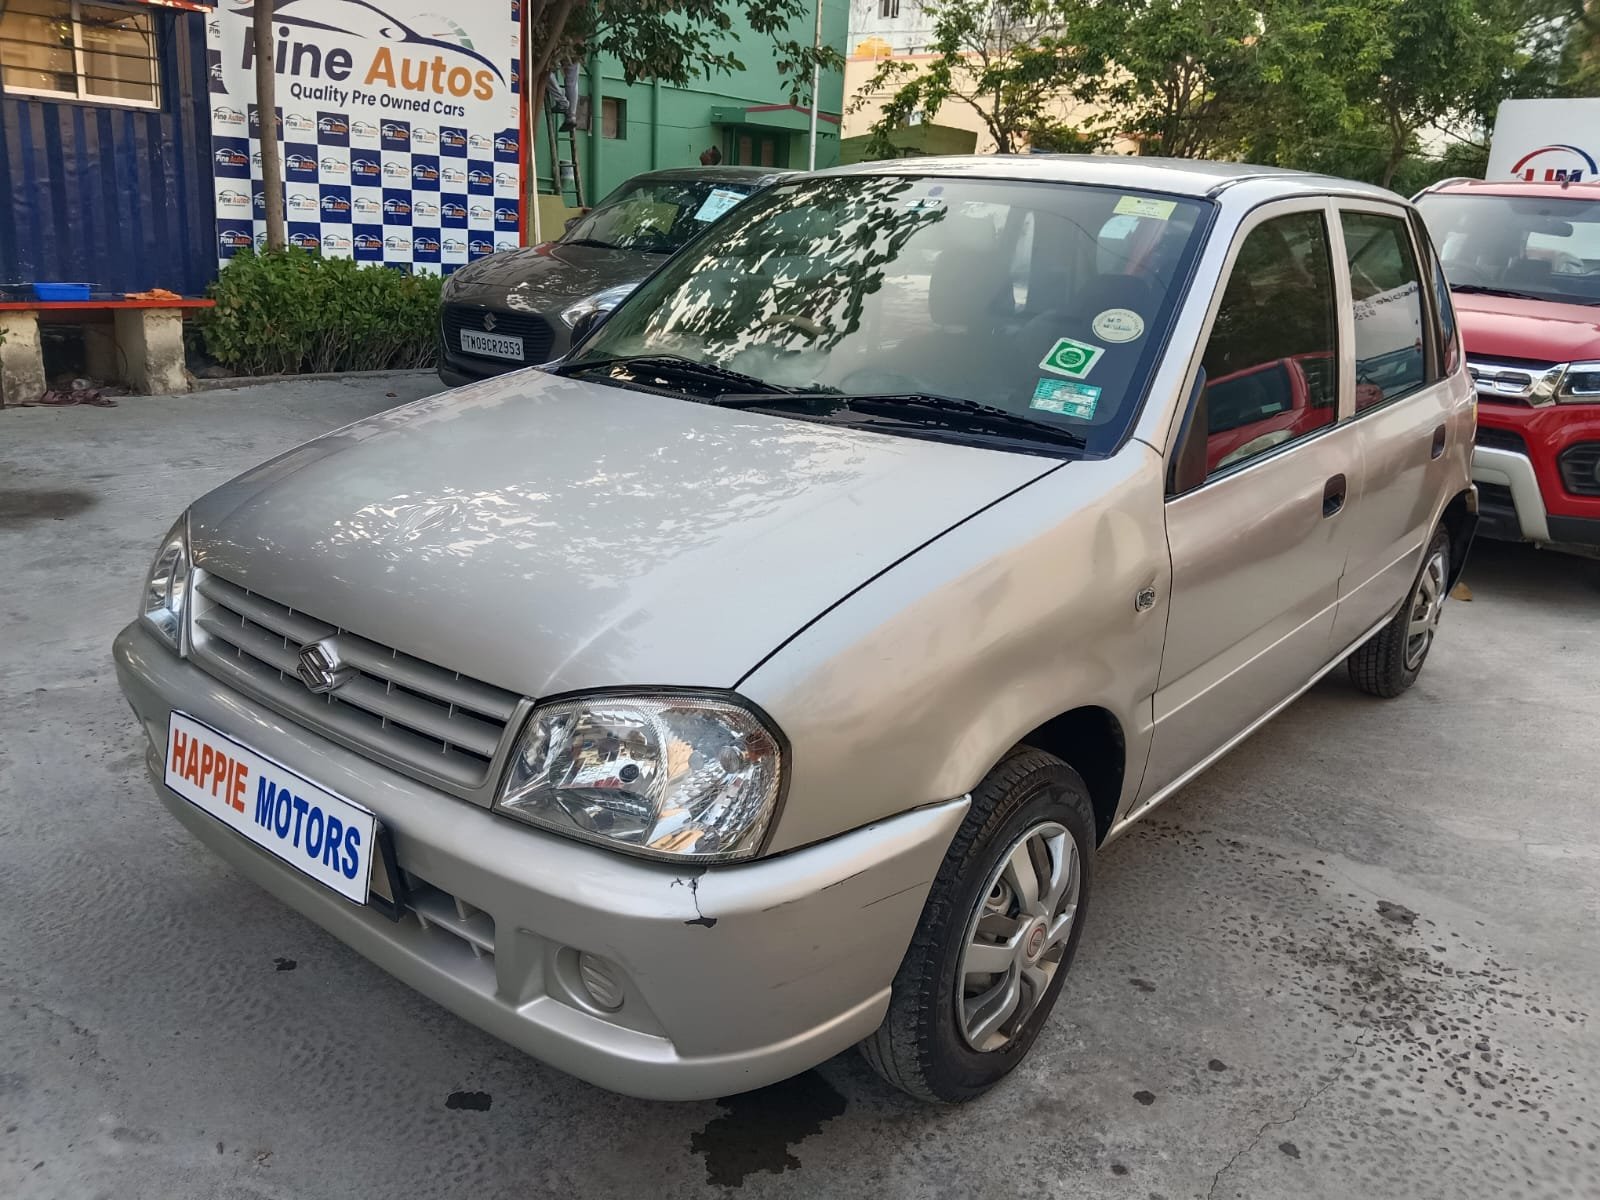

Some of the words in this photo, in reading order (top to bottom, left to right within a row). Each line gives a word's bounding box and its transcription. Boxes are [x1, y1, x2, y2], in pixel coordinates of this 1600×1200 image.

[291, 83, 348, 107] Quality
[352, 91, 376, 105] Pre
[380, 94, 430, 112] Owned
[434, 101, 464, 117] Cars
[364, 47, 494, 100] Autos
[171, 728, 248, 814] HAPPIE
[255, 775, 361, 880] MOTORS
